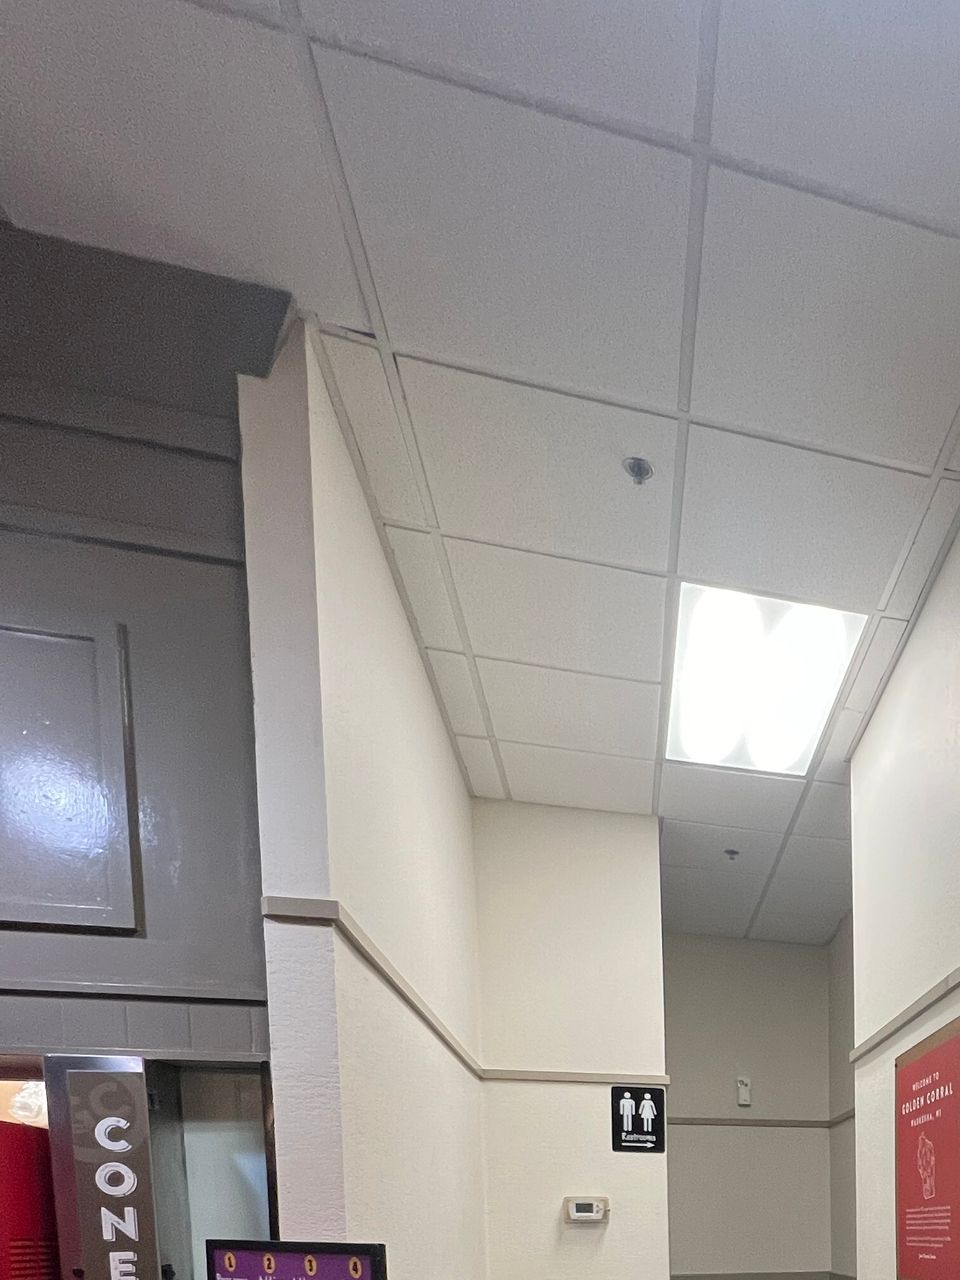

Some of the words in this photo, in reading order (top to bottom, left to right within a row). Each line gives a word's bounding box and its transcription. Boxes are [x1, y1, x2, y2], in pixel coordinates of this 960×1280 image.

[933, 1071, 940, 1081] TO
[901, 1095, 925, 1116] GOLDEN
[926, 1081, 953, 1105] CORRAL
